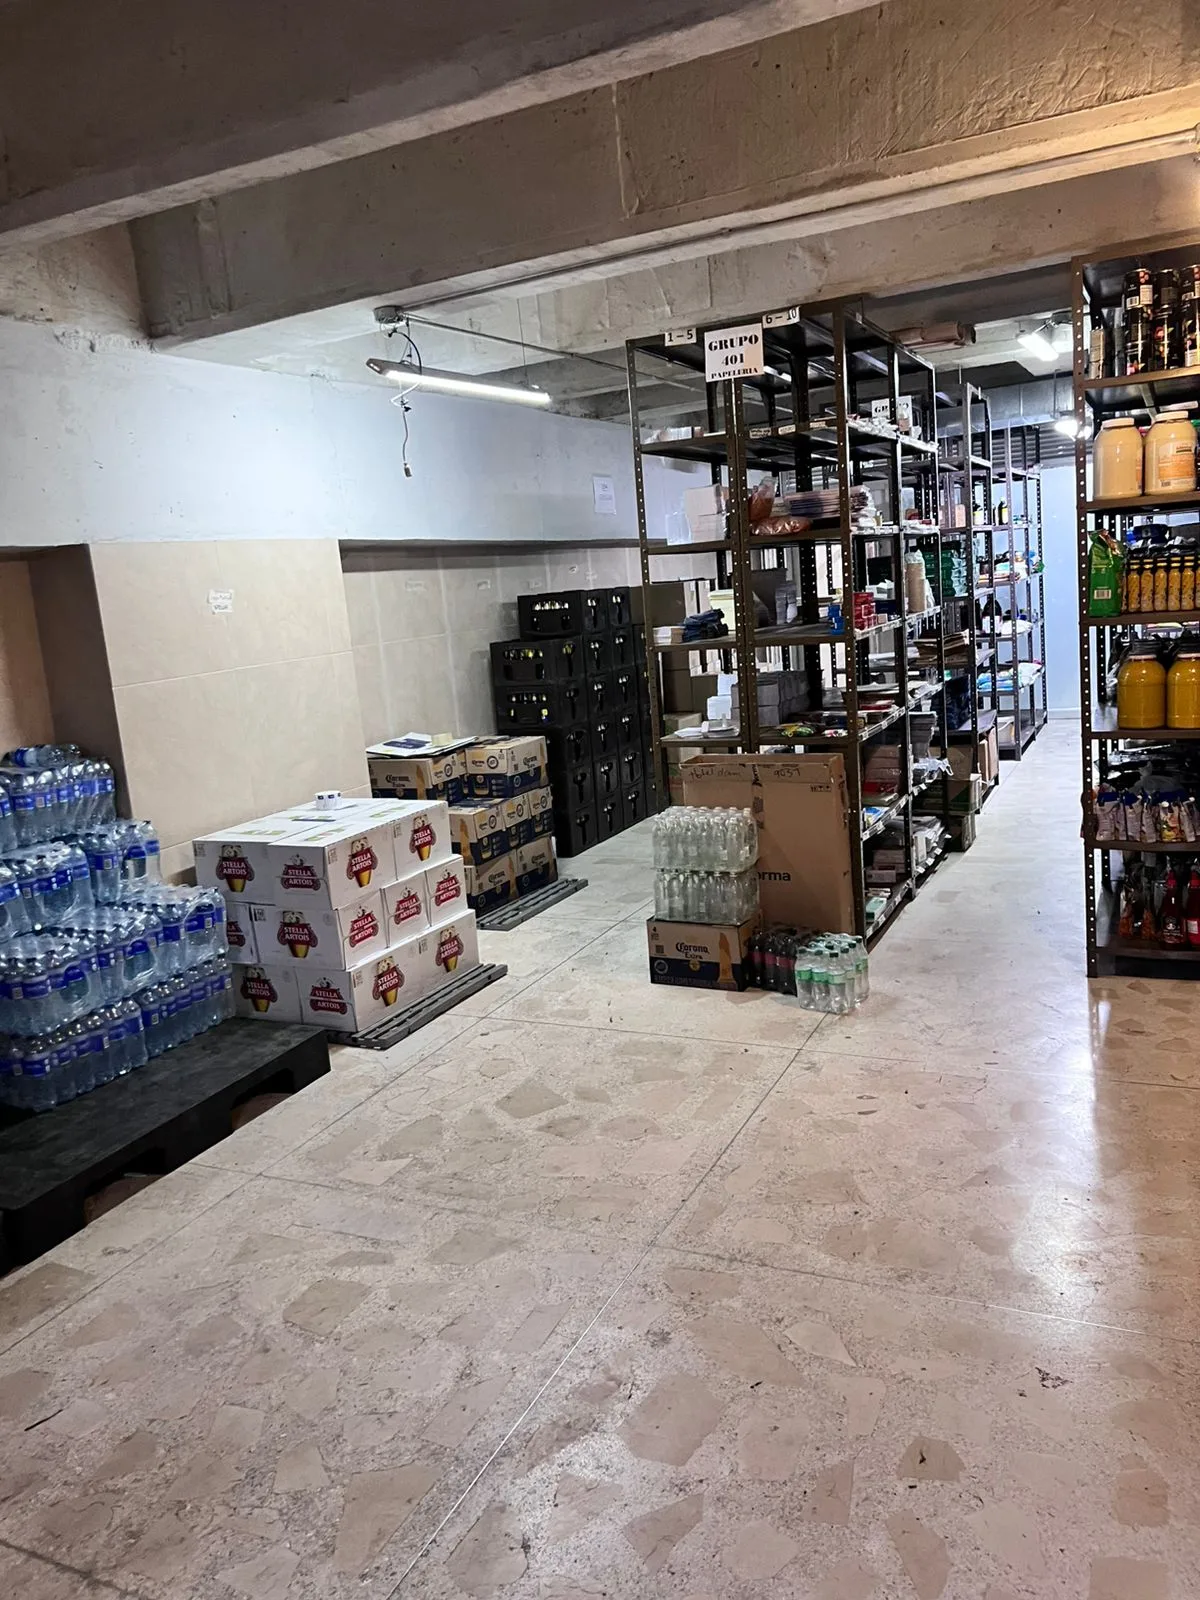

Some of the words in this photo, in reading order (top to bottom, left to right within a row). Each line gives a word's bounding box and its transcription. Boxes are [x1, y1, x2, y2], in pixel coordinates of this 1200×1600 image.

[708, 334, 758, 351] GRUPO
[721, 354, 744, 366] 401
[711, 367, 758, 379] PAPELERIA
[414, 828, 431, 840] STELLA
[414, 835, 432, 846] ARTOIS
[352, 852, 371, 866] STELLA
[222, 868, 247, 876] ARTOIS
[352, 860, 372, 872] ARTOIS
[288, 878, 313, 886] ARTOIS
[439, 879, 456, 890] STELLA
[440, 890, 457, 900] ARTOIS
[400, 898, 416, 909] STELLA
[400, 907, 418, 918] ARTOIS
[353, 916, 372, 929] STELLA
[354, 928, 374, 941] ARTOIS
[676, 942, 710, 954] Corona
[378, 972, 398, 986] STELLA
[378, 978, 398, 992] ARTOIS
[316, 990, 338, 998] STELLA
